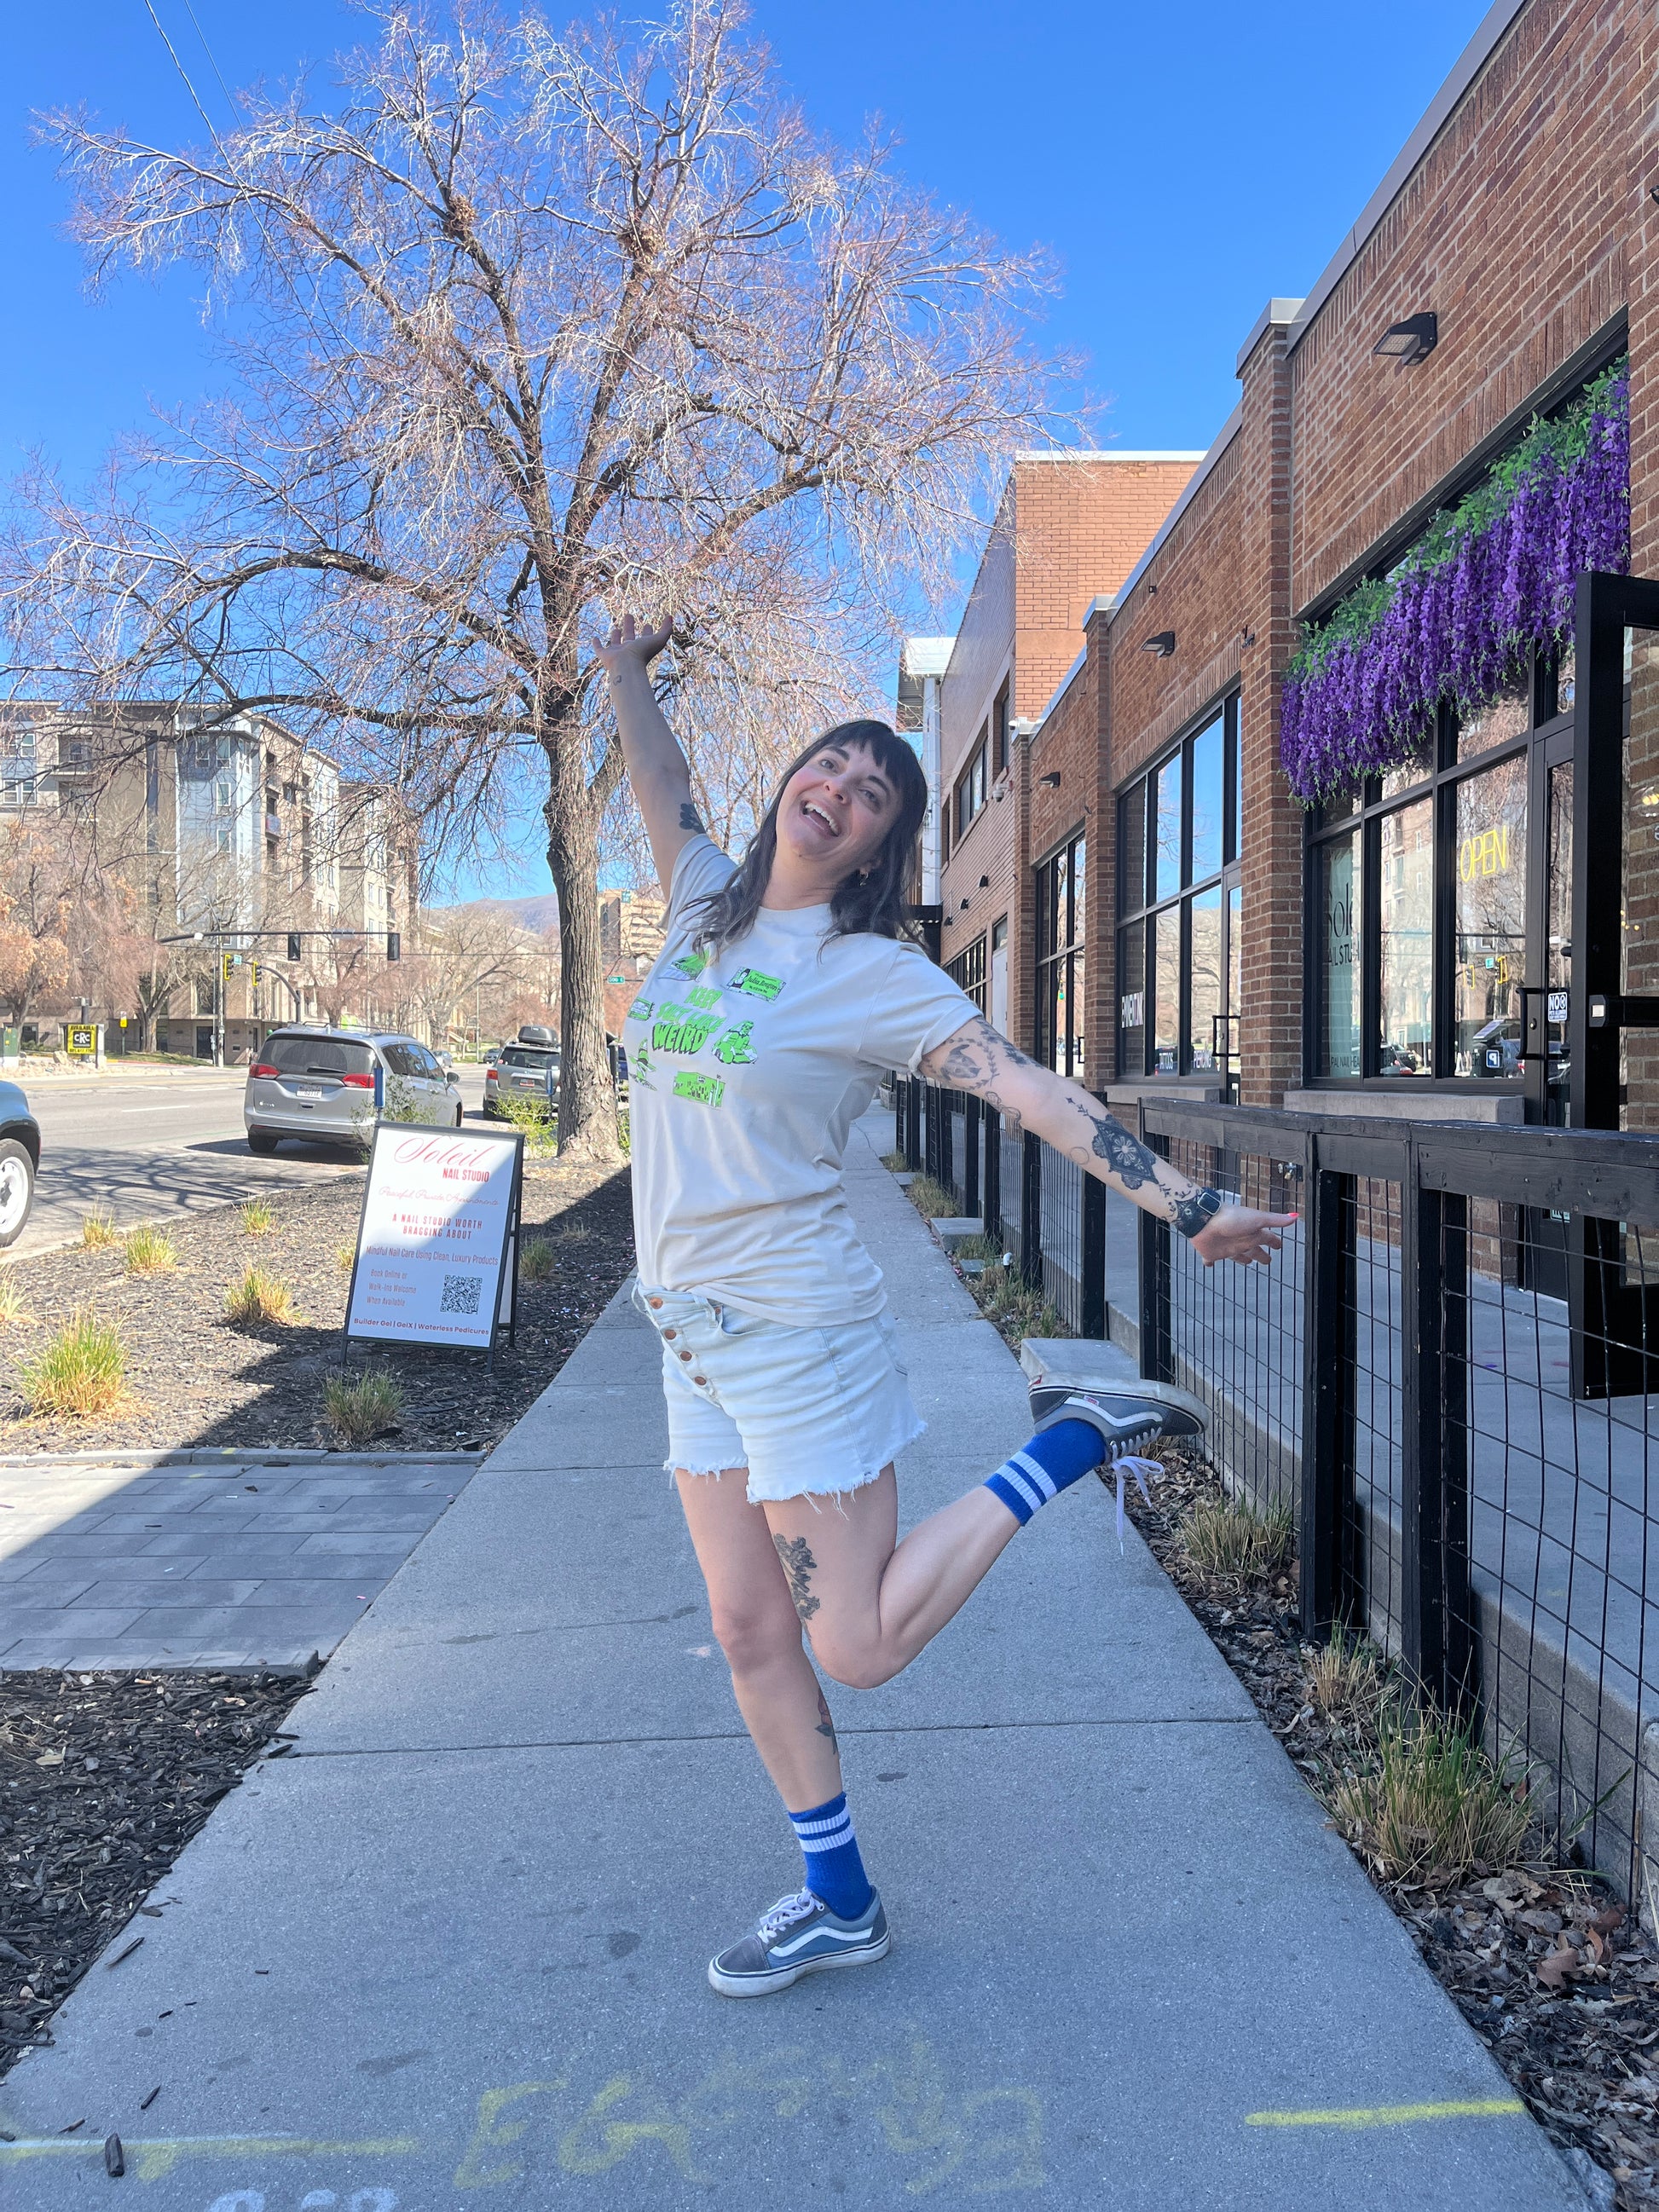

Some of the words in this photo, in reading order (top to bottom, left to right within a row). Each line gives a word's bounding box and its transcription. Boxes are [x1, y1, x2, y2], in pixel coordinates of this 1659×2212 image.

[1460, 825, 1509, 882] OPEN
[1549, 995, 1560, 1010] NO
[74, 1032, 90, 1044] CRC
[652, 1022, 708, 1055] WEIRD
[394, 1135, 496, 1167] Soleil
[442, 1168, 460, 1181] NAIL
[462, 1170, 490, 1182] STUDIO
[392, 1213, 397, 1222] A
[401, 1214, 419, 1224] NAIL
[423, 1216, 452, 1227] STUDIO
[455, 1218, 483, 1229] WORTH
[402, 1225, 442, 1238] BRAGGING
[446, 1229, 472, 1239] ABOUT
[367, 1246, 388, 1256] Mindful
[389, 1247, 401, 1257] Nail
[402, 1249, 415, 1259] Care
[416, 1250, 431, 1261] Using
[452, 1253, 471, 1264] Luxury
[472, 1255, 499, 1266] Products
[371, 1268, 383, 1277] Book
[384, 1269, 400, 1279] Online
[393, 1284, 417, 1294] Welcome
[367, 1296, 381, 1304] When
[382, 1297, 405, 1307] Available
[354, 1318, 379, 1326] Builder
[418, 1324, 453, 1332] Waterless
[454, 1326, 489, 1335] Pedicures
